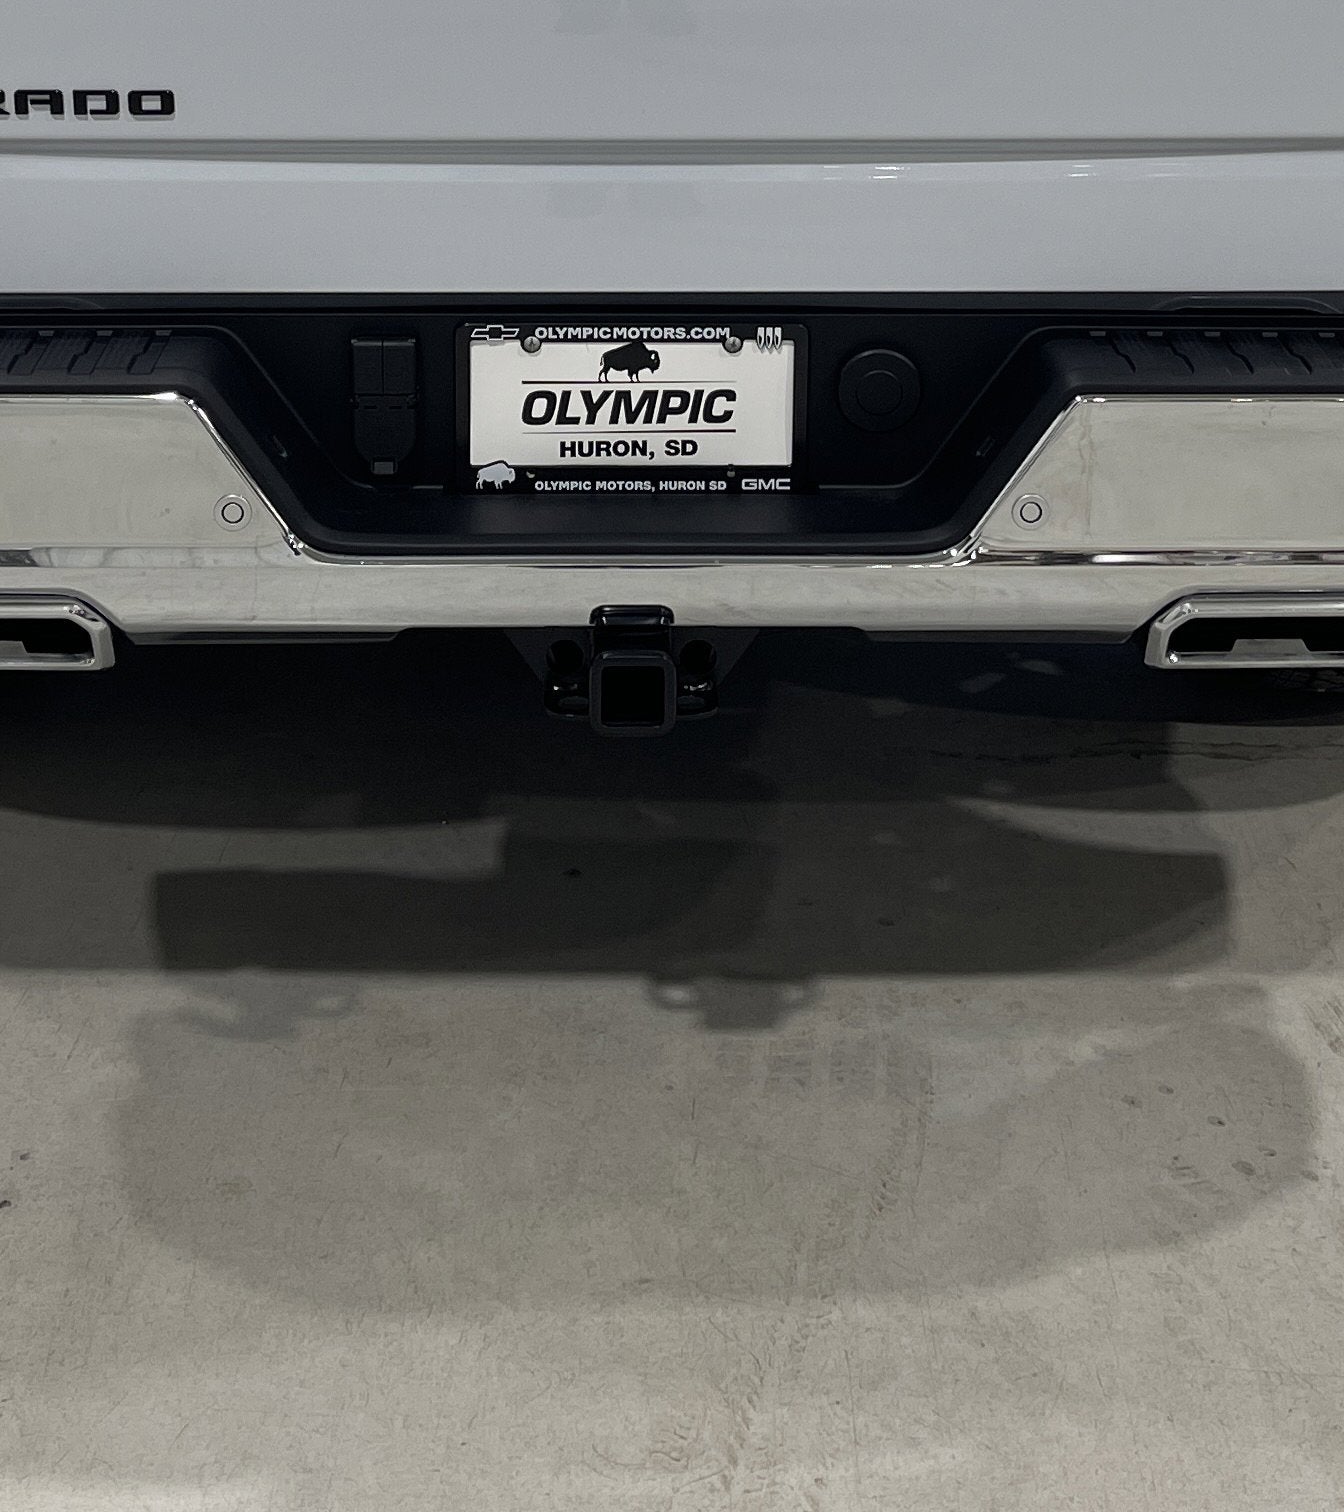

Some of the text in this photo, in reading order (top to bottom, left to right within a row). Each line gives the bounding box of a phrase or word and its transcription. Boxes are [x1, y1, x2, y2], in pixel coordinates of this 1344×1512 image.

[534, 327, 731, 340] OLYMPICMOTORS.COM
[521, 389, 737, 426] OLYMPIC
[559, 440, 698, 459] HURON, SD
[534, 481, 727, 492] OLYMPIC MOTORS, HURON SD
[741, 478, 791, 490] GMC
